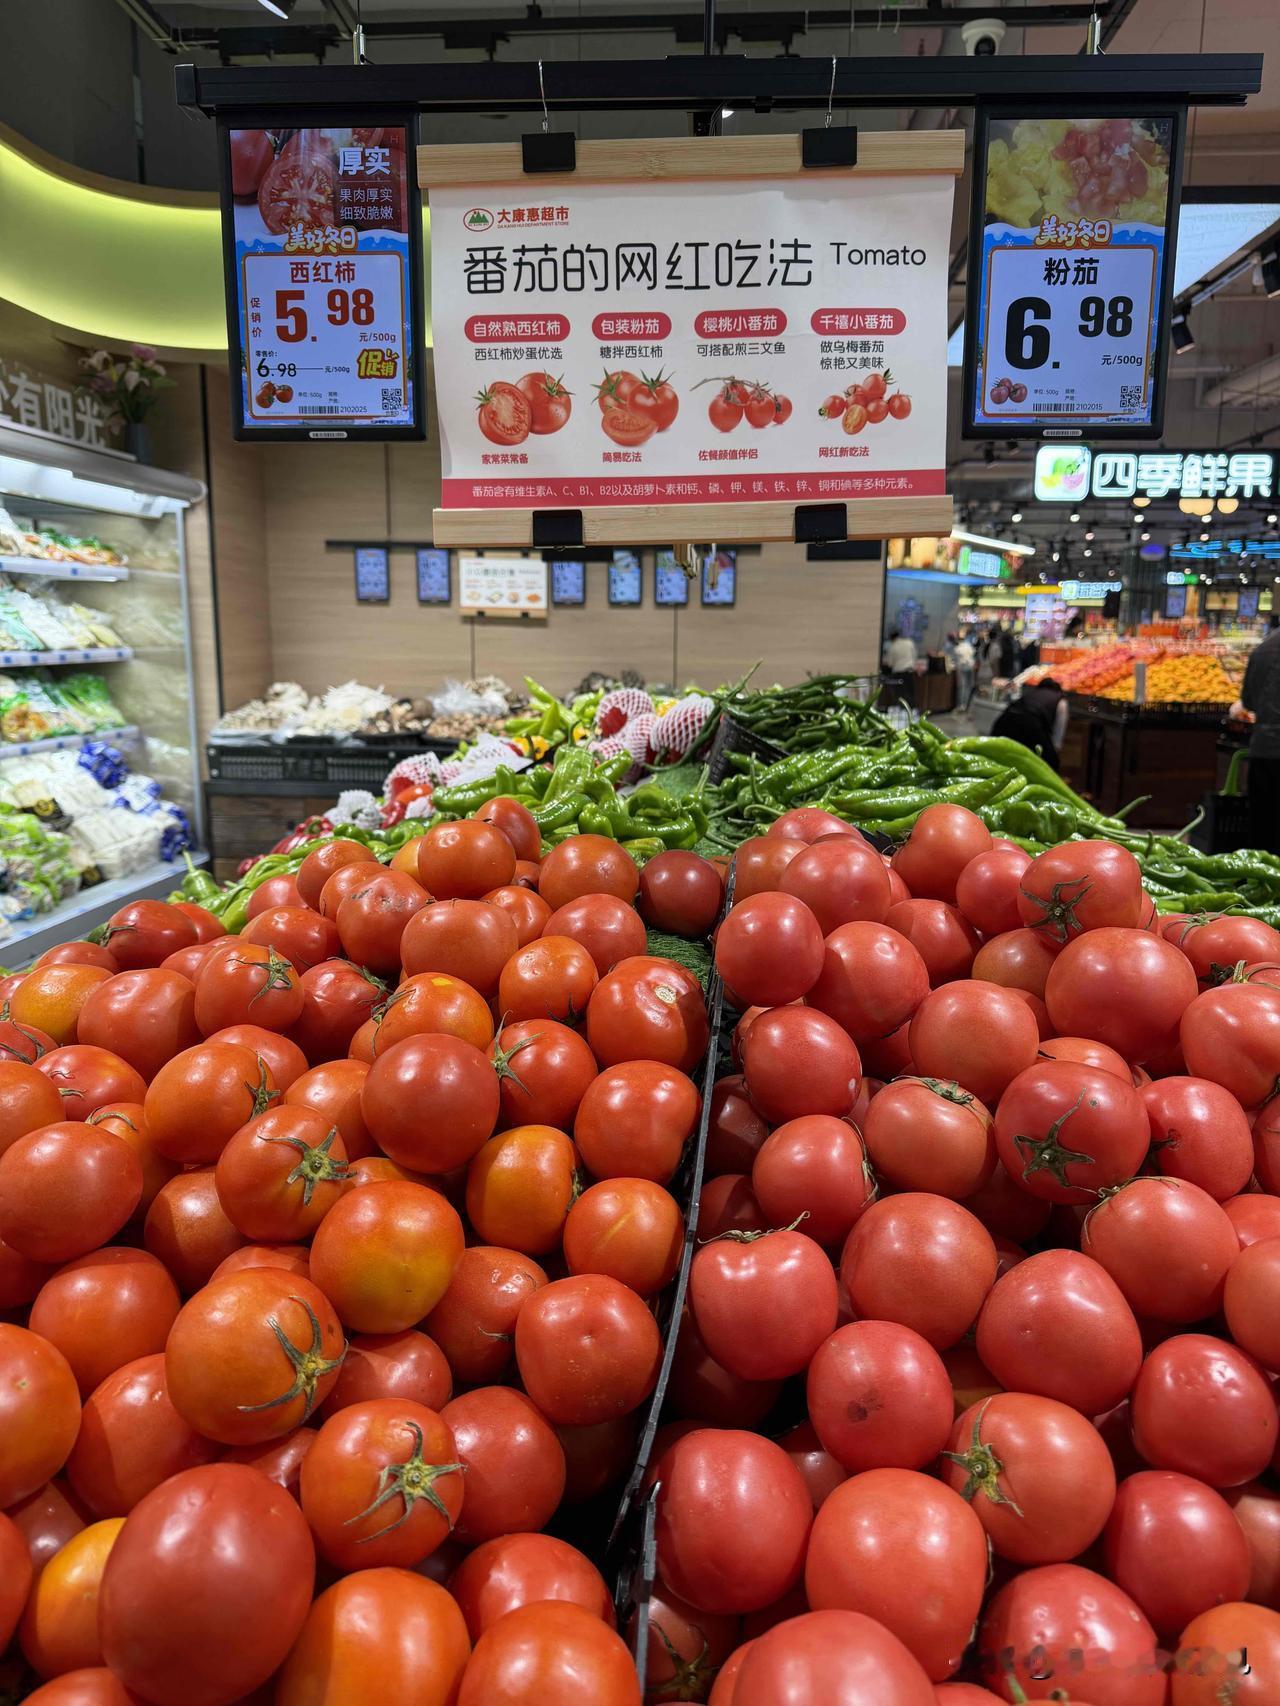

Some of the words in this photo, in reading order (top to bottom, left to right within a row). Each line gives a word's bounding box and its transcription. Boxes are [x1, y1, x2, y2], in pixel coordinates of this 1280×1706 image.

[338, 145, 391, 176] 厚实
[339, 188, 393, 203] 果肉厚实
[339, 206, 394, 221] 细致脆嫩
[497, 205, 569, 224] 大康惠超市
[285, 222, 357, 254] 美好冬日
[1035, 215, 1111, 247] 美好冬日
[289, 260, 356, 284] 西红柿
[463, 238, 813, 294] 番茄的网红吃法
[829, 241, 927, 266] Tomato
[1043, 257, 1100, 286] 粉茄
[250, 297, 263, 338] 促销价
[703, 315, 778, 333] 樱桃小番茄
[819, 314, 894, 330] 千禧小番茄
[473, 321, 561, 337] 自然熟西红柿
[600, 318, 660, 335] 包装粉茄
[359, 332, 397, 343] 元/500g
[474, 346, 563, 361] 西红柿炒蛋优选
[599, 344, 663, 359] 糖拌西红柿
[696, 342, 786, 357] 可搭配煎三文鱼
[820, 340, 885, 354] 做乌梅番茄
[257, 358, 297, 378] 6.98
[358, 349, 400, 378] 促销
[820, 356, 884, 370] 惊艳又美味
[1101, 355, 1143, 367] 元/500g
[481, 453, 529, 465] 家常菜常备
[602, 451, 642, 463] 简易吃法
[698, 448, 758, 461] 佐餐颜值伴侣
[818, 446, 870, 458] 网红新吃法
[1092, 453, 1273, 498] 四季鲜果
